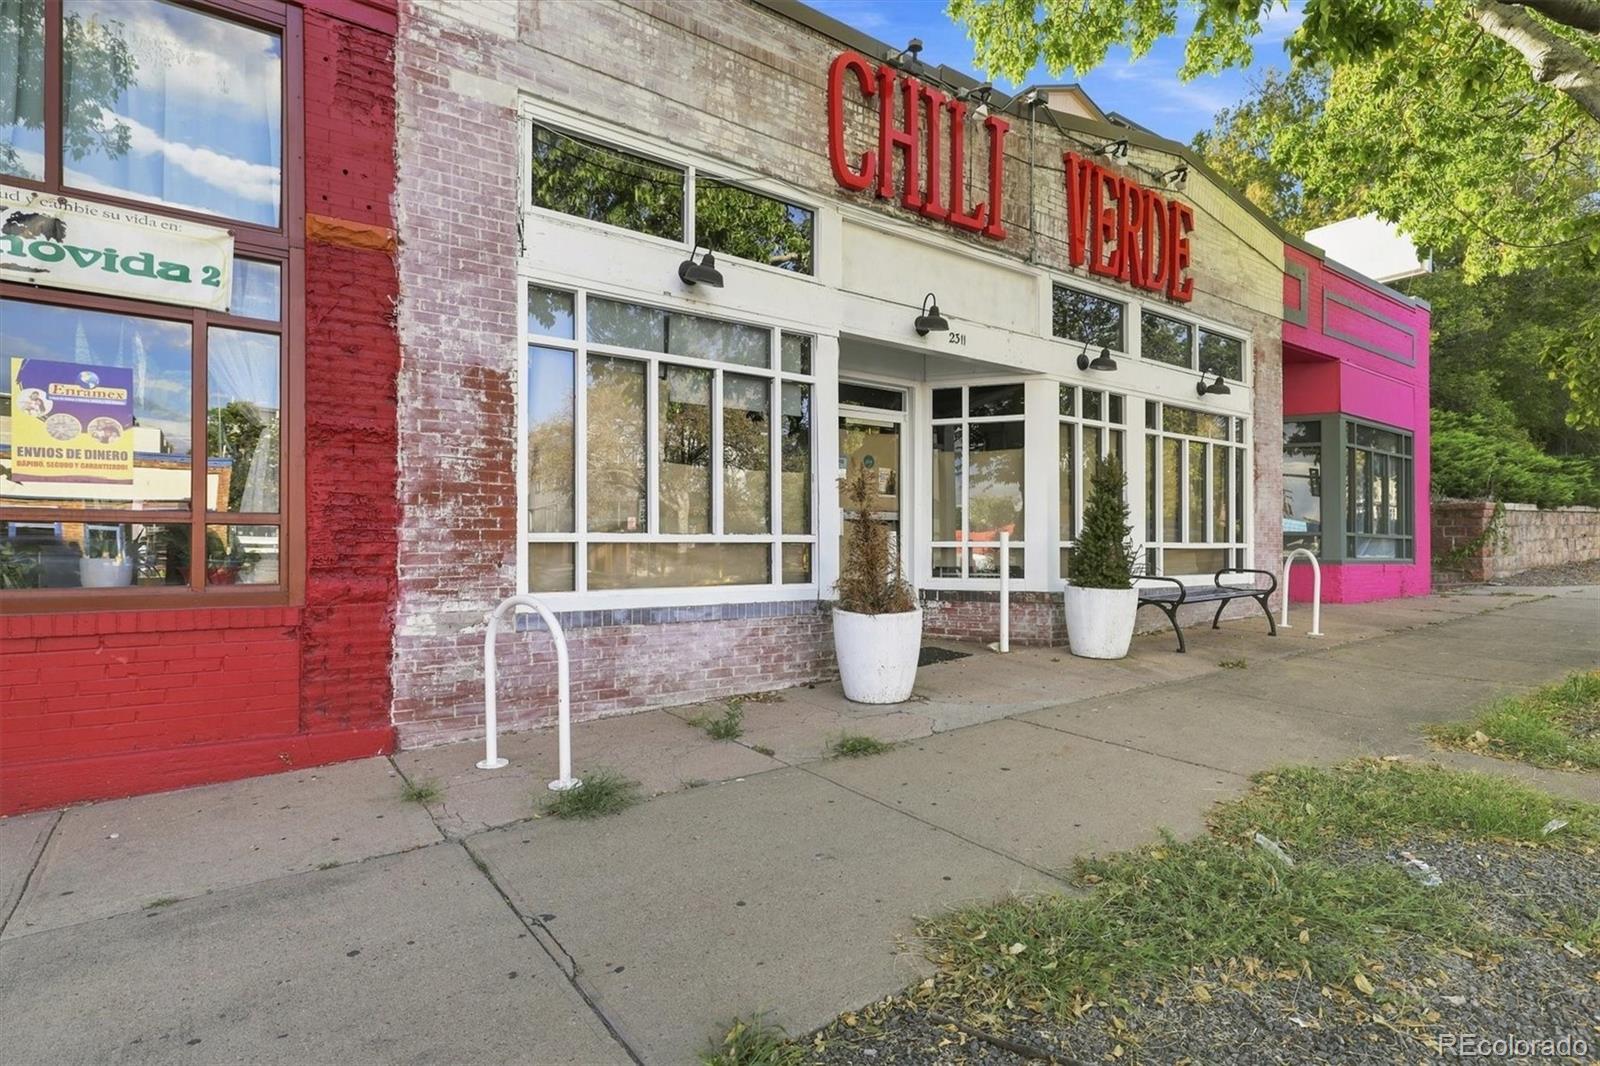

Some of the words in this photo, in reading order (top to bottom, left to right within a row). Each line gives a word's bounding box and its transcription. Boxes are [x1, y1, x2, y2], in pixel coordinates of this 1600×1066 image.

[827, 50, 1009, 241] CHILI
[1063, 151, 1195, 302] VERDE
[102, 210, 121, 221] su
[125, 214, 158, 227] vida
[161, 221, 183, 232] en:
[201, 265, 222, 288] 2
[52, 384, 125, 400] Enramex
[17, 446, 64, 459] ENVIOS
[66, 448, 82, 460] DE
[84, 449, 129, 462] DINERO
